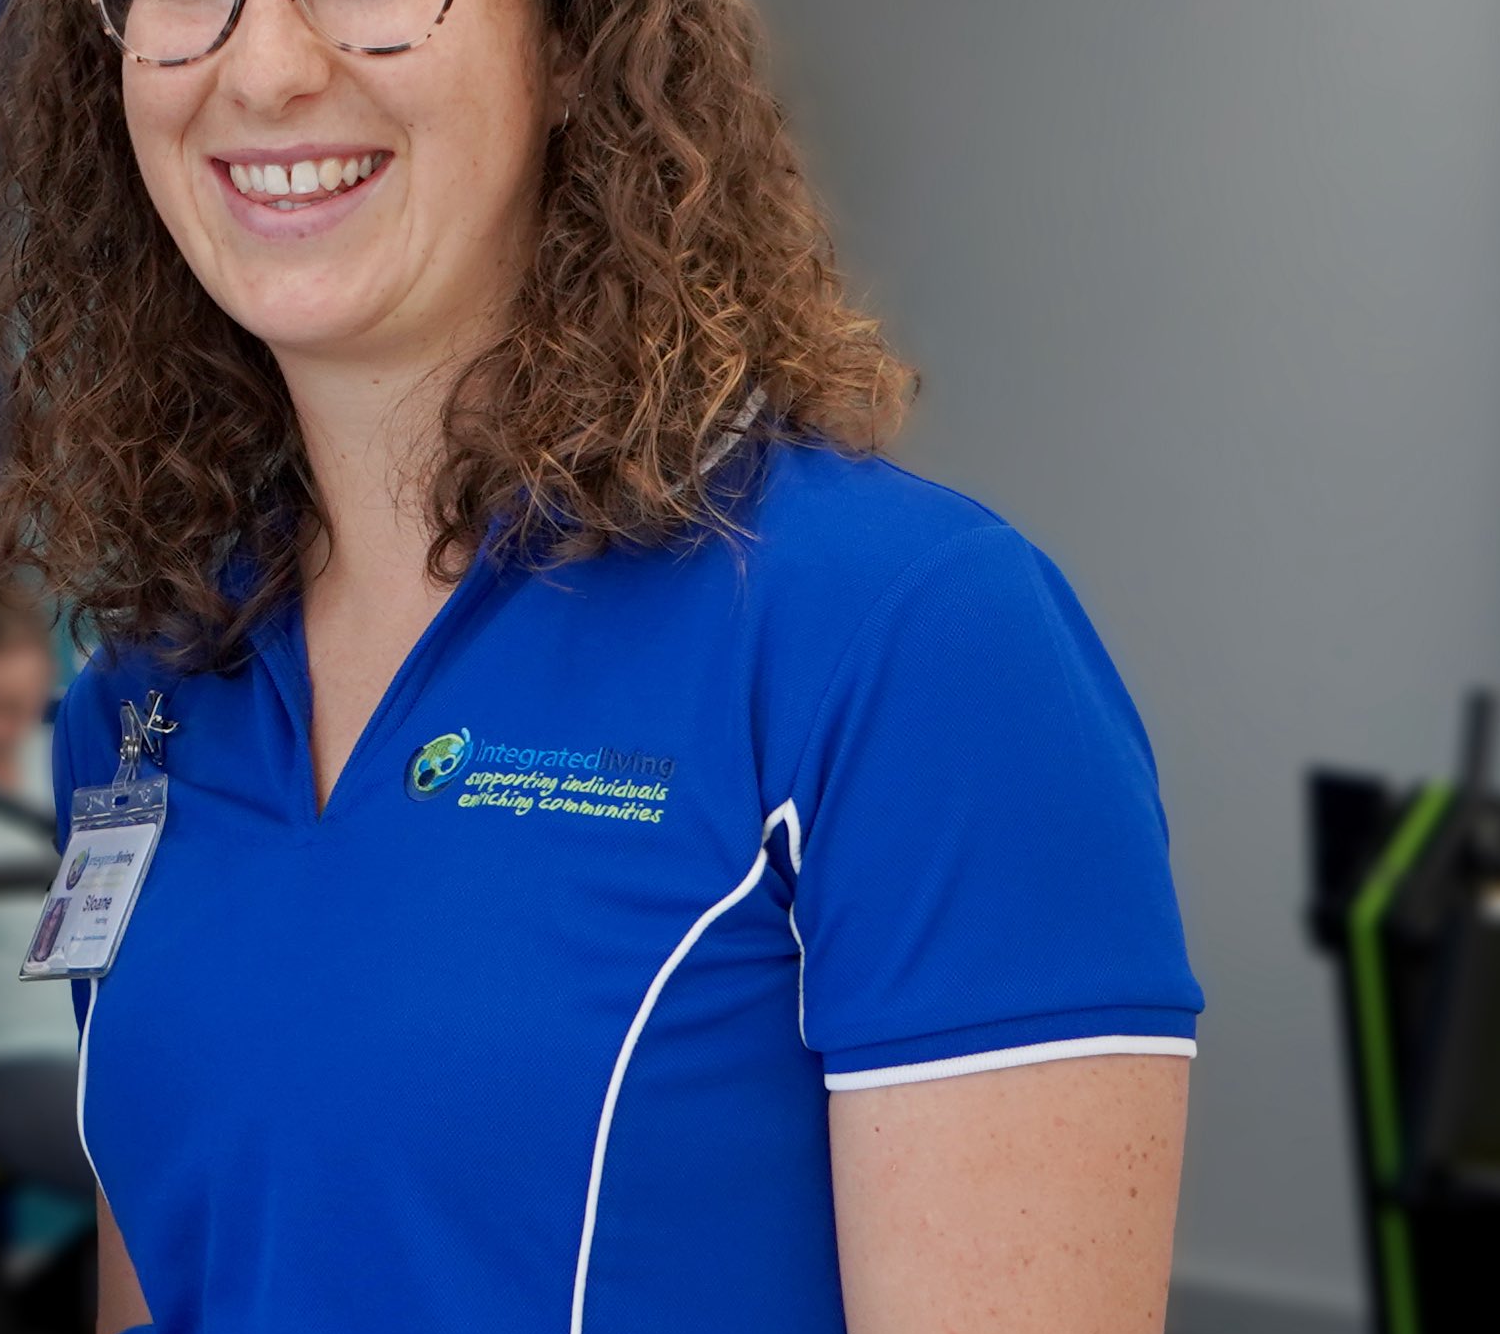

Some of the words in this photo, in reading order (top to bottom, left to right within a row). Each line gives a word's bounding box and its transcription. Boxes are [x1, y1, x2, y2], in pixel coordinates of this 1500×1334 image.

[464, 771, 559, 797] supporting
[561, 773, 669, 801] individuals
[458, 788, 534, 816] enriching
[538, 796, 665, 823] communities
[82, 894, 113, 912] Sloane
